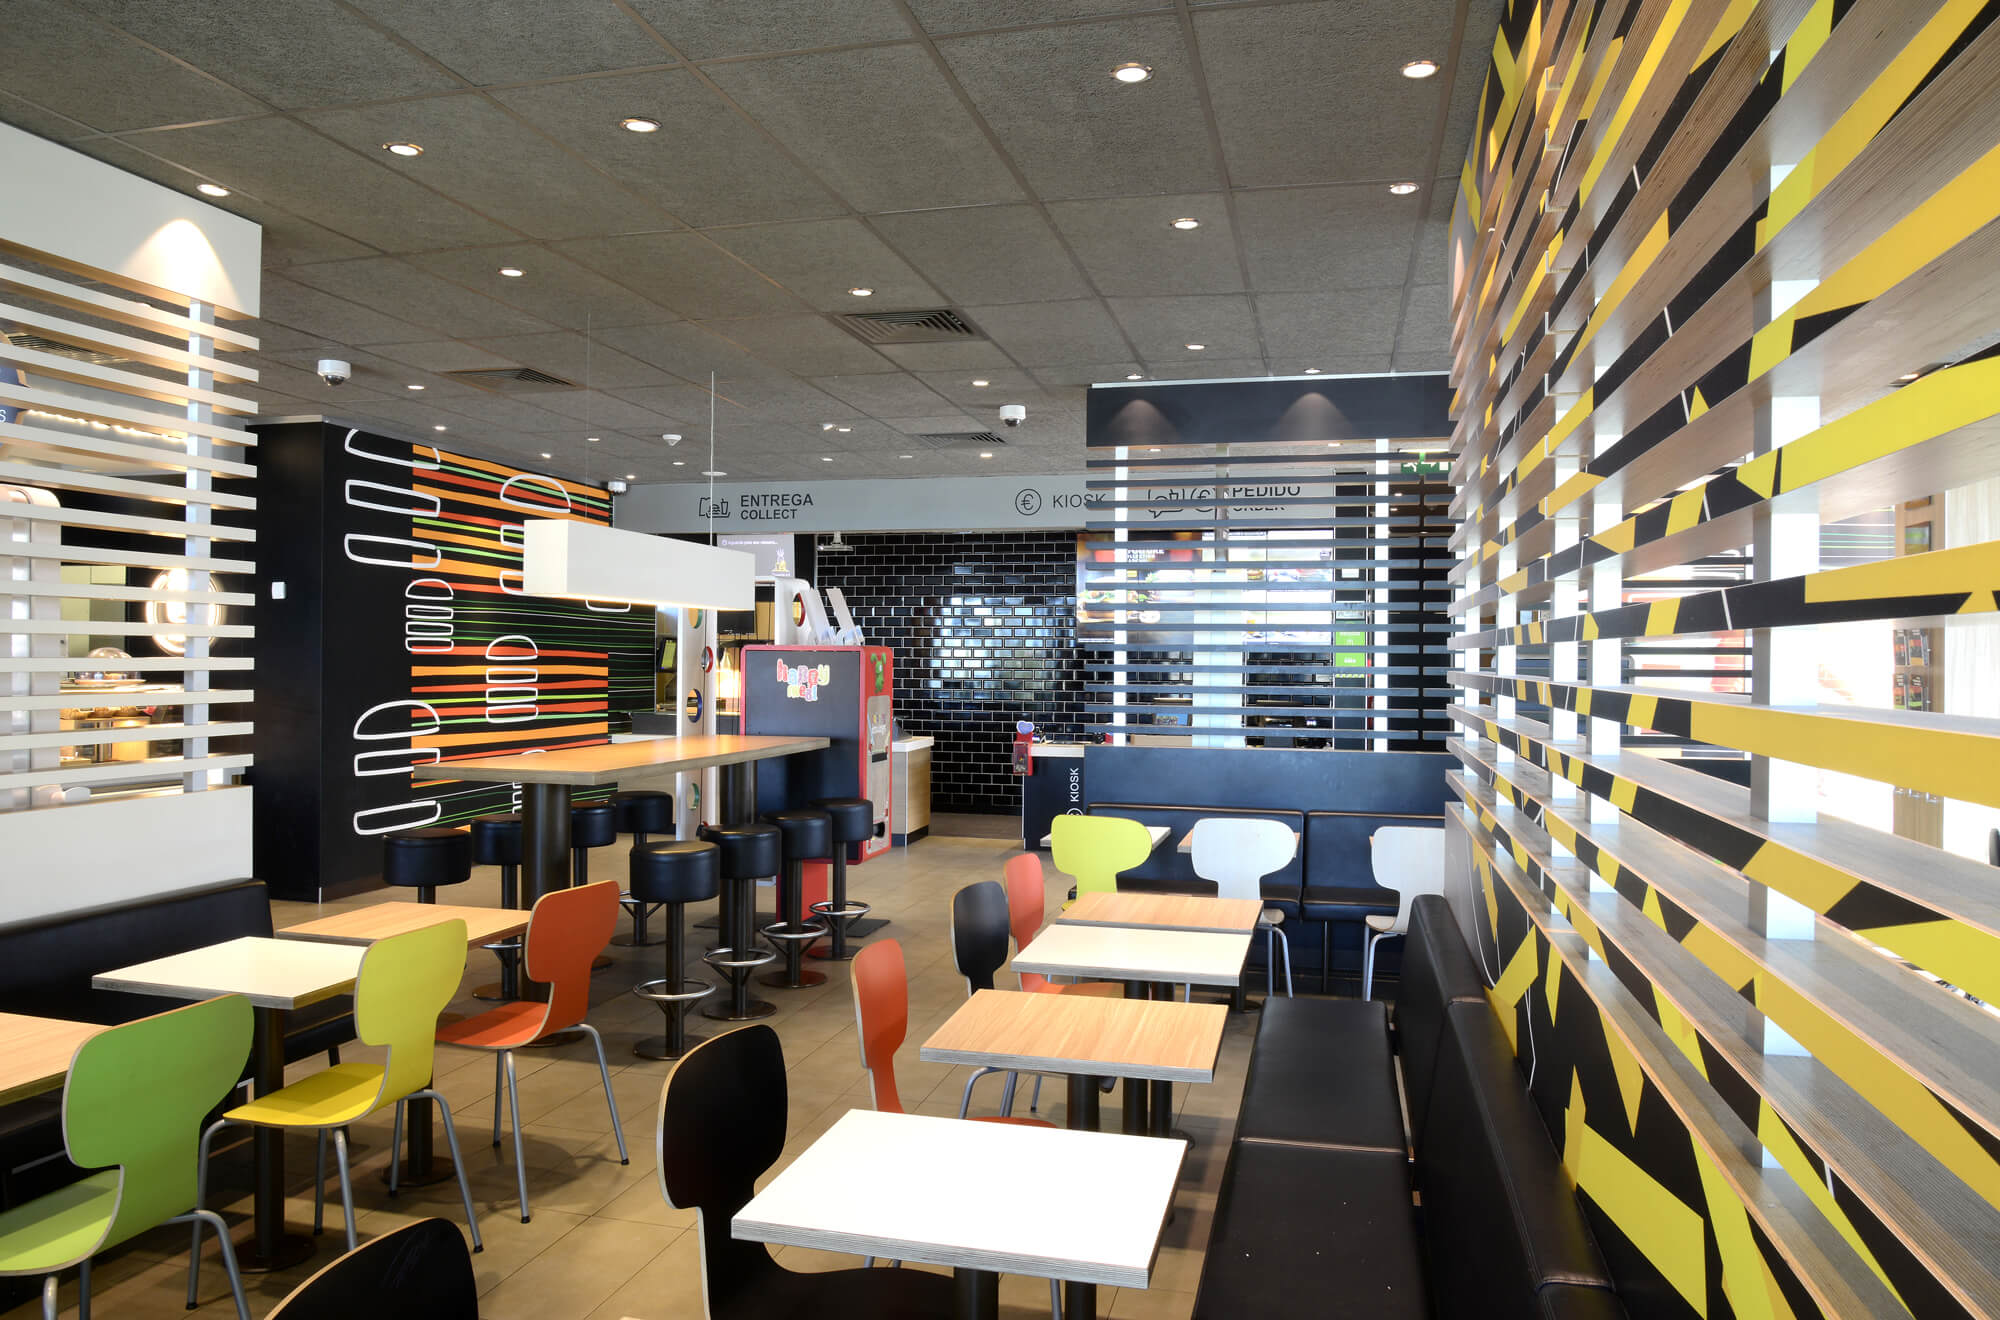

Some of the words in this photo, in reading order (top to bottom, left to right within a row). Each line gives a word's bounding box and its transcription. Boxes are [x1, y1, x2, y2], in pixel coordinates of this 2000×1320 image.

[740, 493, 814, 507] ENTREGA
[740, 508, 798, 520] COLLECT
[776, 658, 830, 688] happy
[787, 684, 818, 702] meal
[1069, 767, 1080, 802] KIOSK
